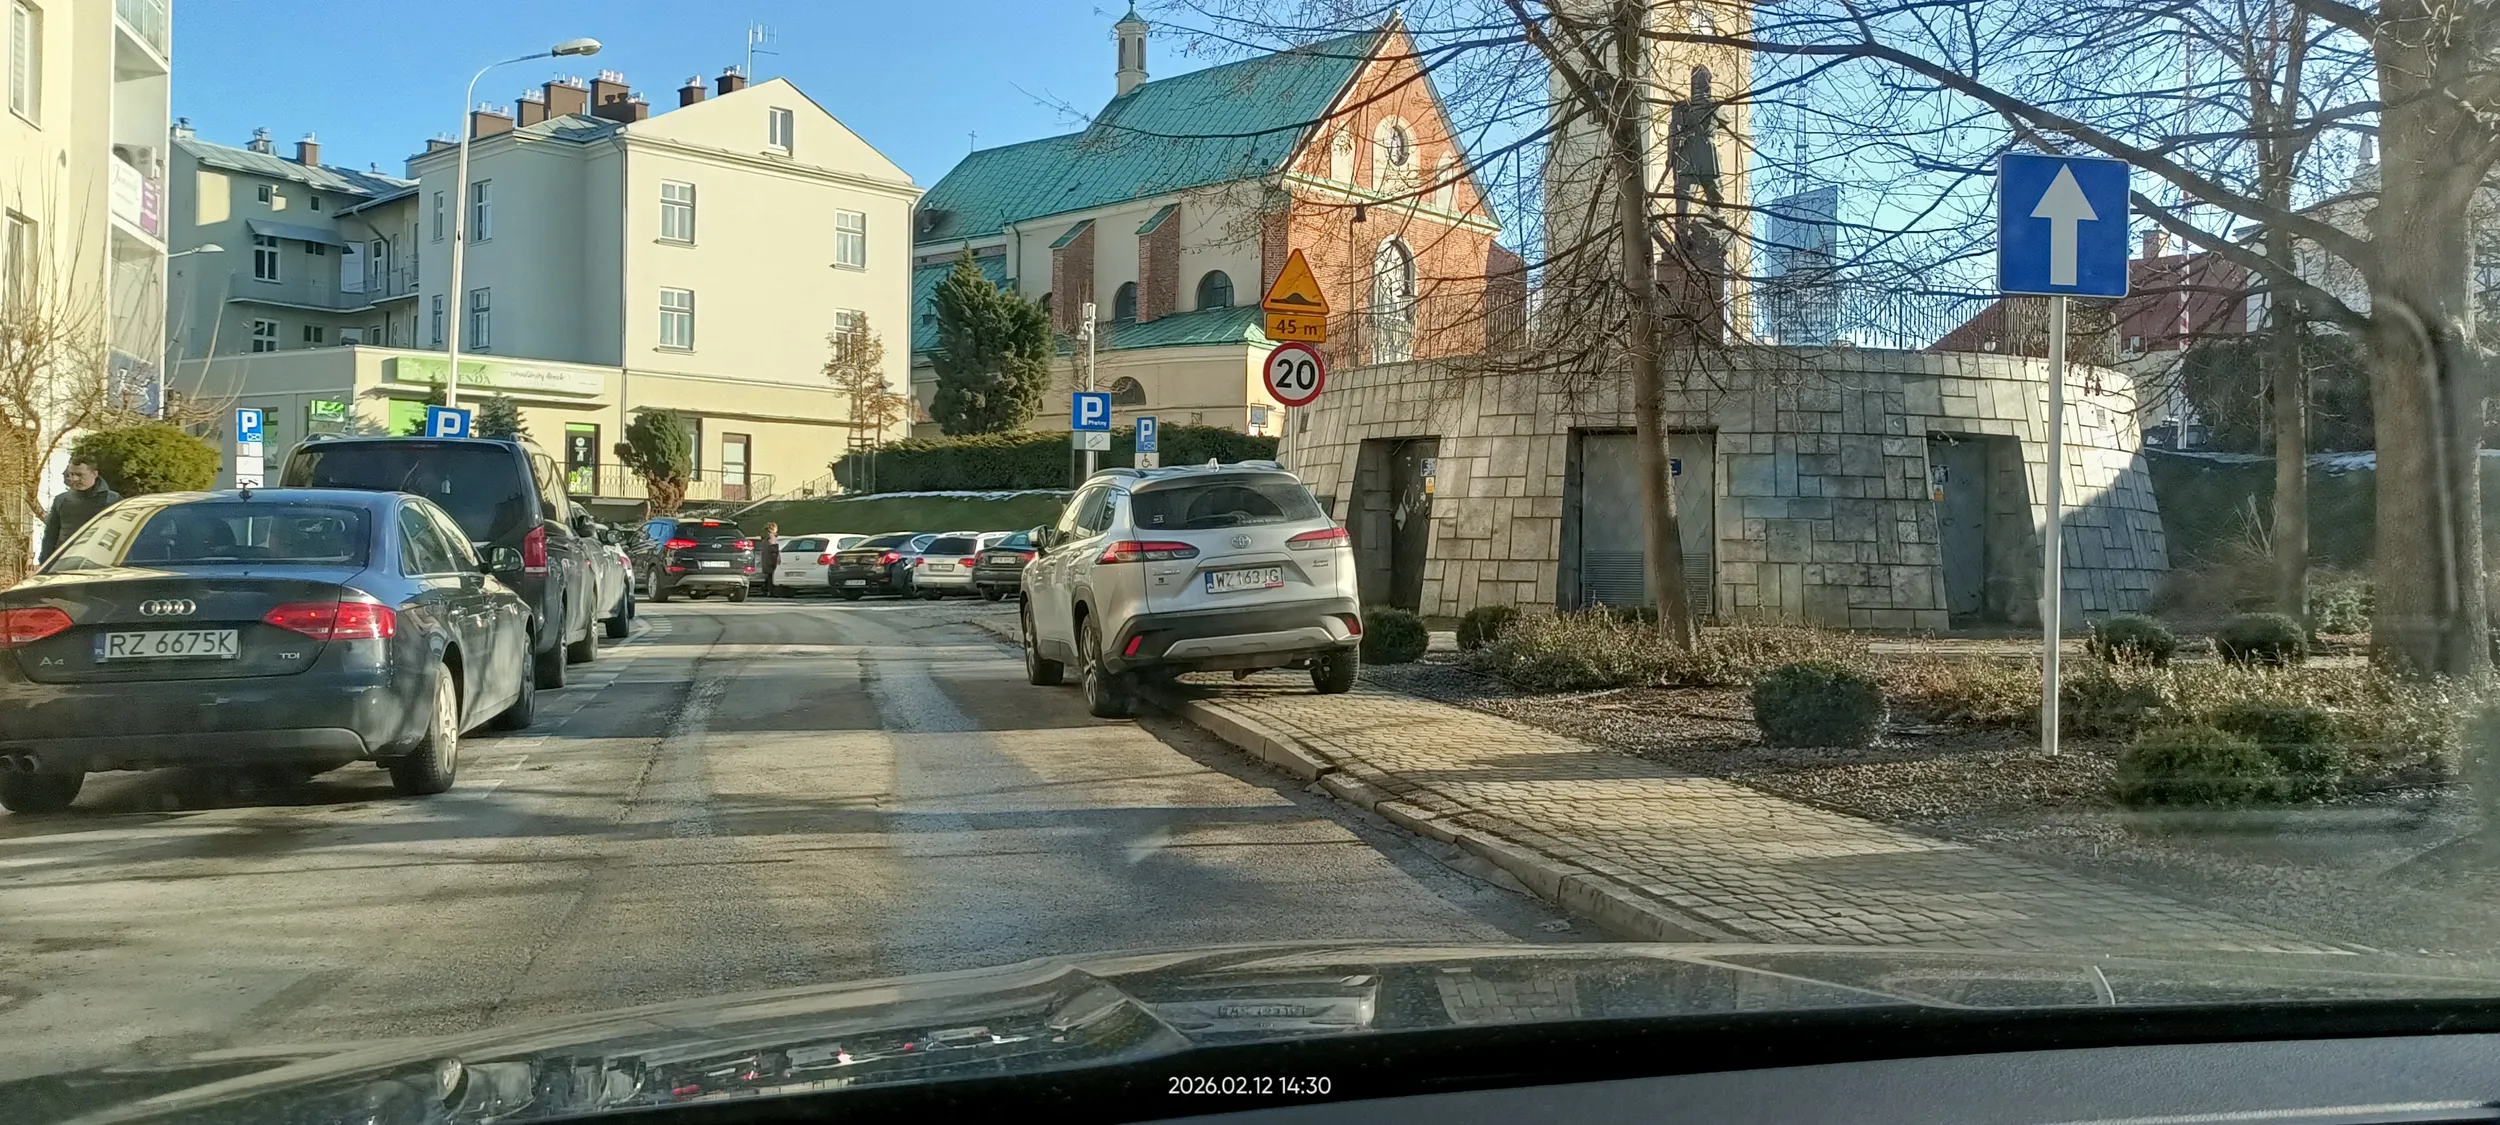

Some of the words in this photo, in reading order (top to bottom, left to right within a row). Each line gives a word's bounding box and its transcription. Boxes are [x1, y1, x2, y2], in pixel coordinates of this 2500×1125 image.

[1276, 319, 1297, 334] 45
[1303, 324, 1317, 335] m
[1275, 358, 1316, 390] 20
[241, 411, 258, 433] P
[1081, 396, 1103, 426] P
[436, 410, 462, 438] P
[1141, 419, 1153, 442] P
[110, 633, 146, 656] RZ
[155, 631, 234, 654] 6675K
[39, 656, 65, 667] A4
[279, 652, 300, 660] TDI
